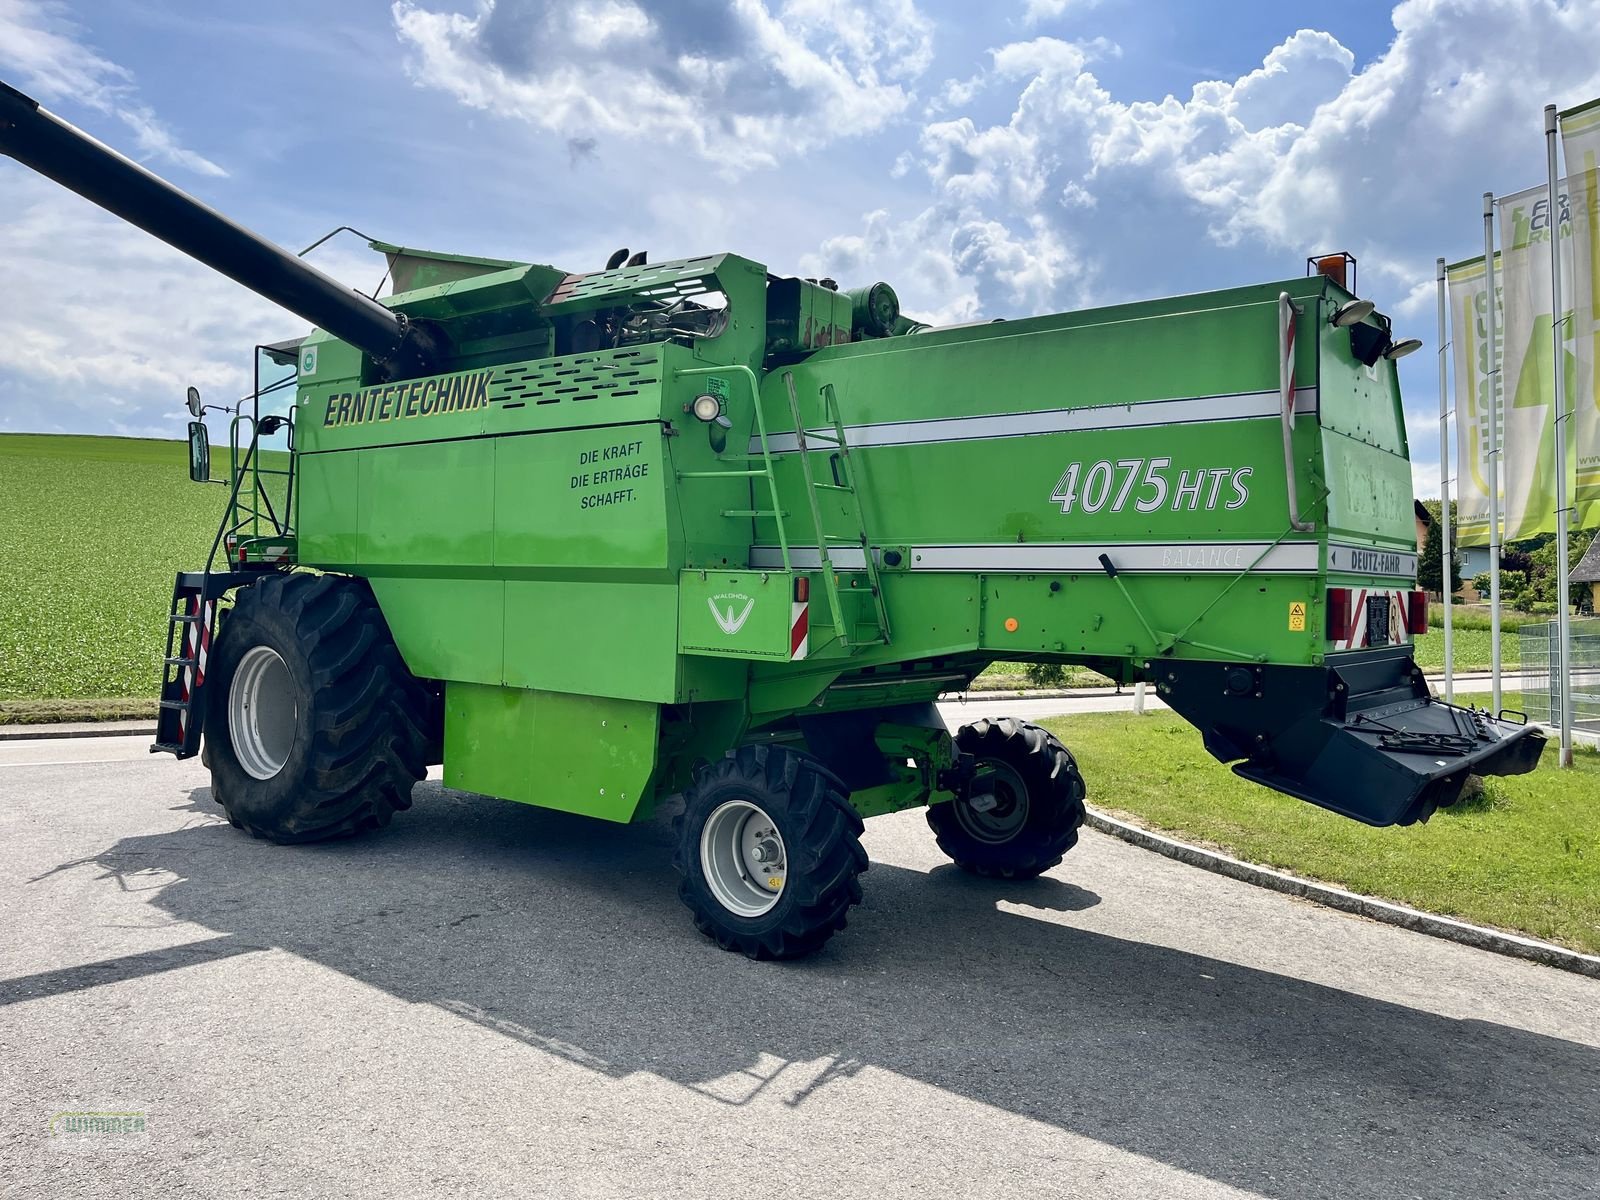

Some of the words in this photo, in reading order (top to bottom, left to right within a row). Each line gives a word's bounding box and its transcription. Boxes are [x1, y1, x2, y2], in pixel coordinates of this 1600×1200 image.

[323, 370, 496, 428] ERNTETECHNIK
[580, 450, 599, 465] DIE
[602, 441, 643, 461] KRAFT
[570, 474, 589, 489] DIE
[593, 463, 649, 486] ERTRÄGE
[1049, 457, 1172, 514] 4075
[1171, 467, 1254, 512] HTS
[580, 489, 638, 510] SCHAFFT.
[1162, 548, 1243, 567] BALANCE
[1351, 550, 1400, 573] DEUTZ-FAHR
